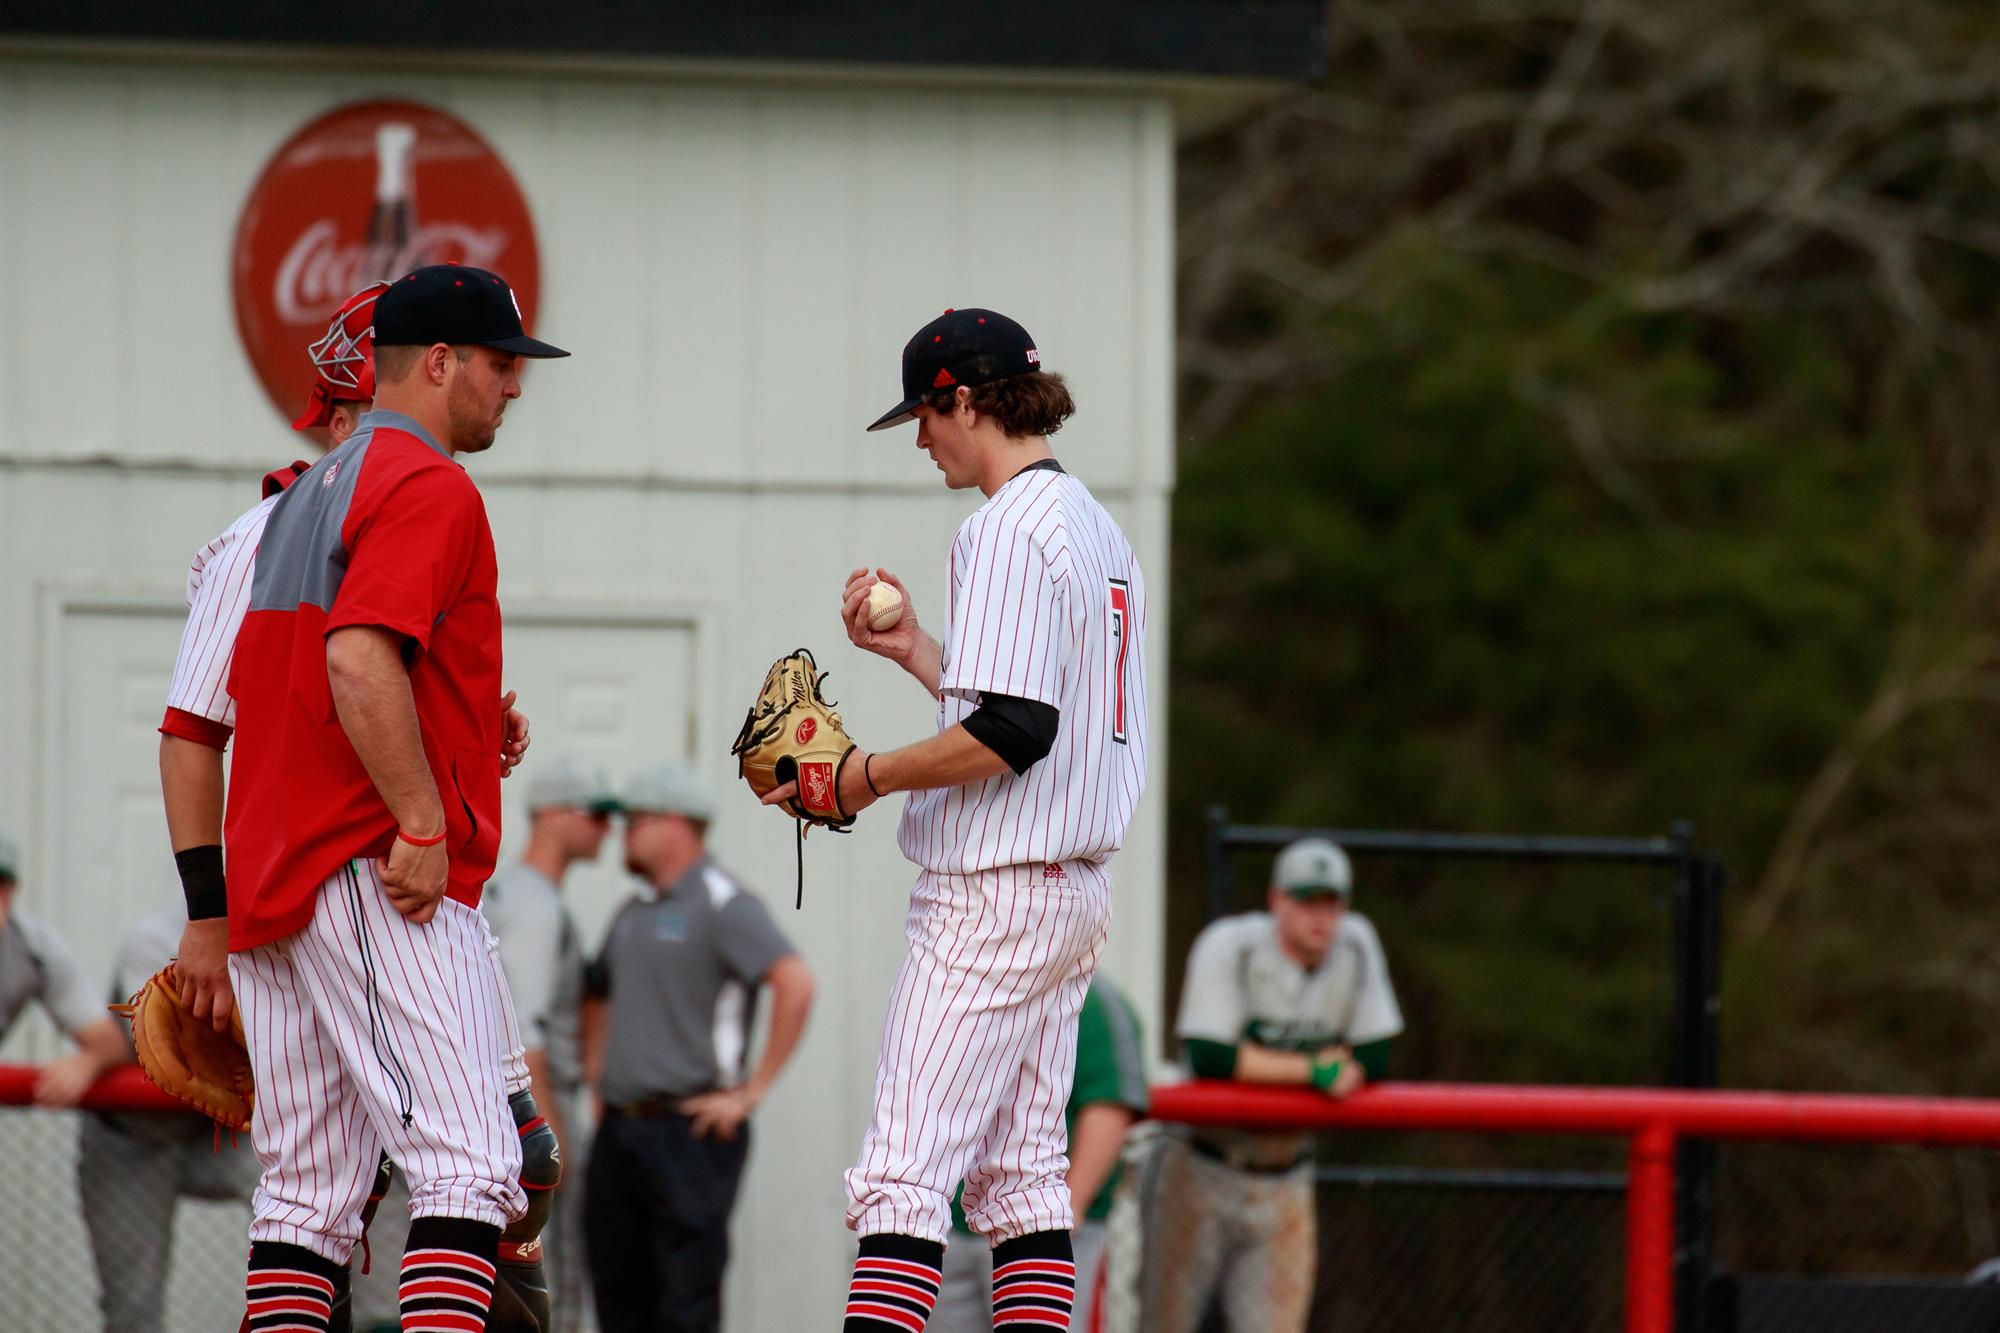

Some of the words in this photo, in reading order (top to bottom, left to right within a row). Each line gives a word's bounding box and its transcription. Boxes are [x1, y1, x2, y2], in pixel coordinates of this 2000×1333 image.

[1108, 578, 1131, 745] 7
[790, 670, 805, 702] Miller
[808, 767, 825, 806] Rawlings
[1043, 870, 1068, 880] adidas
